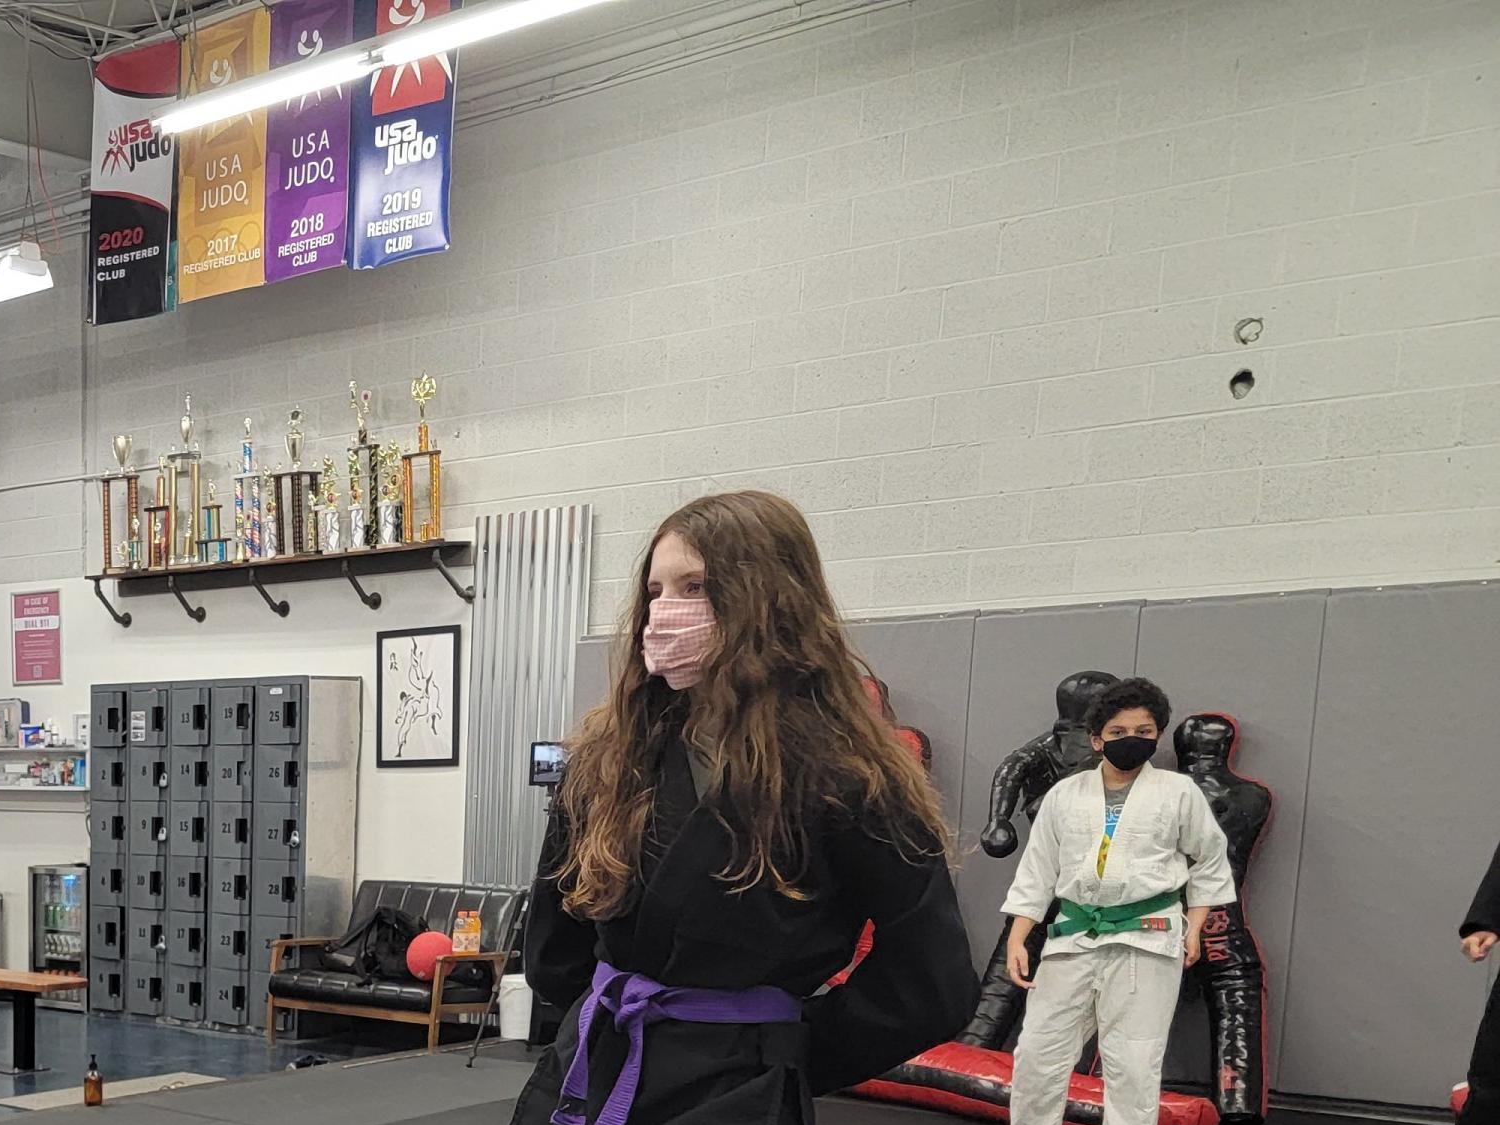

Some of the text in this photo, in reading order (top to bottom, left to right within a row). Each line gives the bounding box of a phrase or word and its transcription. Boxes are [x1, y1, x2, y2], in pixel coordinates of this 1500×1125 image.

[119, 119, 153, 146] usa
[374, 118, 418, 148] usa
[130, 130, 172, 172] judo
[292, 129, 330, 158] USA
[384, 131, 437, 176] judo
[206, 154, 242, 181] USA
[285, 157, 334, 190] JUDO
[200, 180, 247, 211] JUDO
[382, 188, 422, 216] 2019
[290, 213, 324, 238] 2018
[367, 211, 433, 238] REGISTERED
[99, 227, 144, 251] 2020
[208, 234, 238, 256] 2017
[278, 233, 335, 258] REGISTERED
[385, 235, 413, 255] CLUB
[98, 246, 160, 267] REGISTERED
[183, 248, 261, 274] REGISTERED CLUB
[292, 251, 318, 267] CLUB
[97, 269, 125, 281] CLUB
[181, 713, 190, 724] 13
[224, 707, 233, 719] 19
[269, 711, 280, 722] 25
[180, 764, 190, 775] 14
[222, 768, 232, 779] 20
[269, 767, 280, 778] 26
[179, 821, 188, 831] 15
[222, 823, 231, 834] 21
[268, 829, 279, 840] 27
[222, 882, 232, 892] 22
[268, 884, 280, 895] 28
[138, 928, 146, 937] 11
[177, 929, 185, 939] 17
[221, 936, 230, 946] 23
[137, 979, 145, 989] 12
[219, 991, 229, 1000] 24
